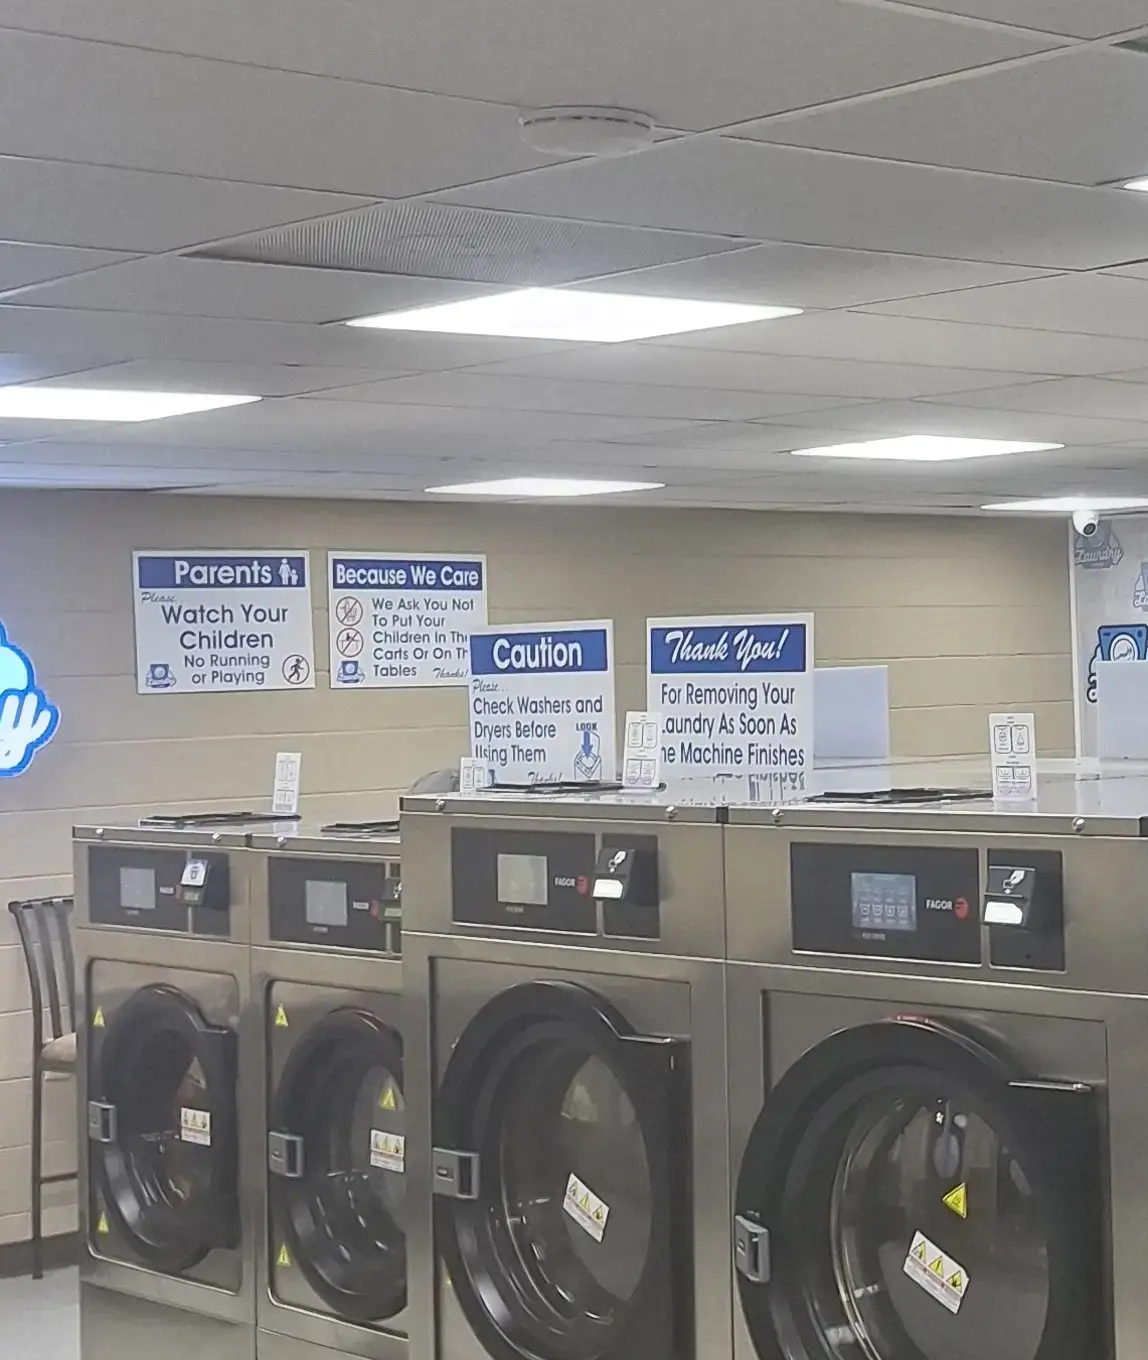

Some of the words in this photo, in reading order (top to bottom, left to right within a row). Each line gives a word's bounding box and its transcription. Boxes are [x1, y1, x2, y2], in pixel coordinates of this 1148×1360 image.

[1076, 546, 1122, 566] Laundry
[175, 559, 272, 584] Parents
[336, 564, 406, 585] Because
[410, 566, 436, 586] We
[440, 566, 478, 586] Care
[161, 605, 234, 624] Watch
[241, 604, 288, 623] Your
[372, 598, 393, 610] We
[398, 598, 420, 610] Ask
[424, 598, 448, 610] You
[452, 598, 474, 610] Not
[372, 614, 388, 627] To
[392, 614, 412, 627] Put
[417, 615, 446, 628] Your
[180, 630, 273, 650] Children
[372, 631, 430, 644] Children
[435, 631, 446, 644] In
[450, 631, 467, 643] Th
[373, 648, 409, 660] Carts
[413, 648, 428, 660] Or
[433, 648, 452, 660] On
[493, 637, 582, 669] Caution
[665, 630, 730, 664] Thank
[733, 628, 790, 671] You!
[184, 655, 204, 668] No
[210, 654, 270, 668] Running
[373, 664, 416, 676] Tables
[192, 673, 206, 684] or
[212, 670, 264, 685] Playing
[473, 696, 514, 715] Check
[517, 696, 572, 714] Washers
[575, 695, 603, 713] and
[662, 683, 682, 704] For
[686, 683, 757, 710] Removing
[762, 682, 796, 704] Your
[474, 721, 512, 742] Dryers
[516, 720, 556, 738] Before
[576, 722, 598, 732] LOOK
[662, 712, 714, 739] aundry
[718, 712, 734, 734] As
[740, 713, 776, 735] Soon
[780, 713, 796, 734] As
[511, 744, 546, 762] Them
[680, 742, 743, 764] Machine
[748, 742, 804, 766] Finishes
[926, 900, 953, 910] FAGOR
